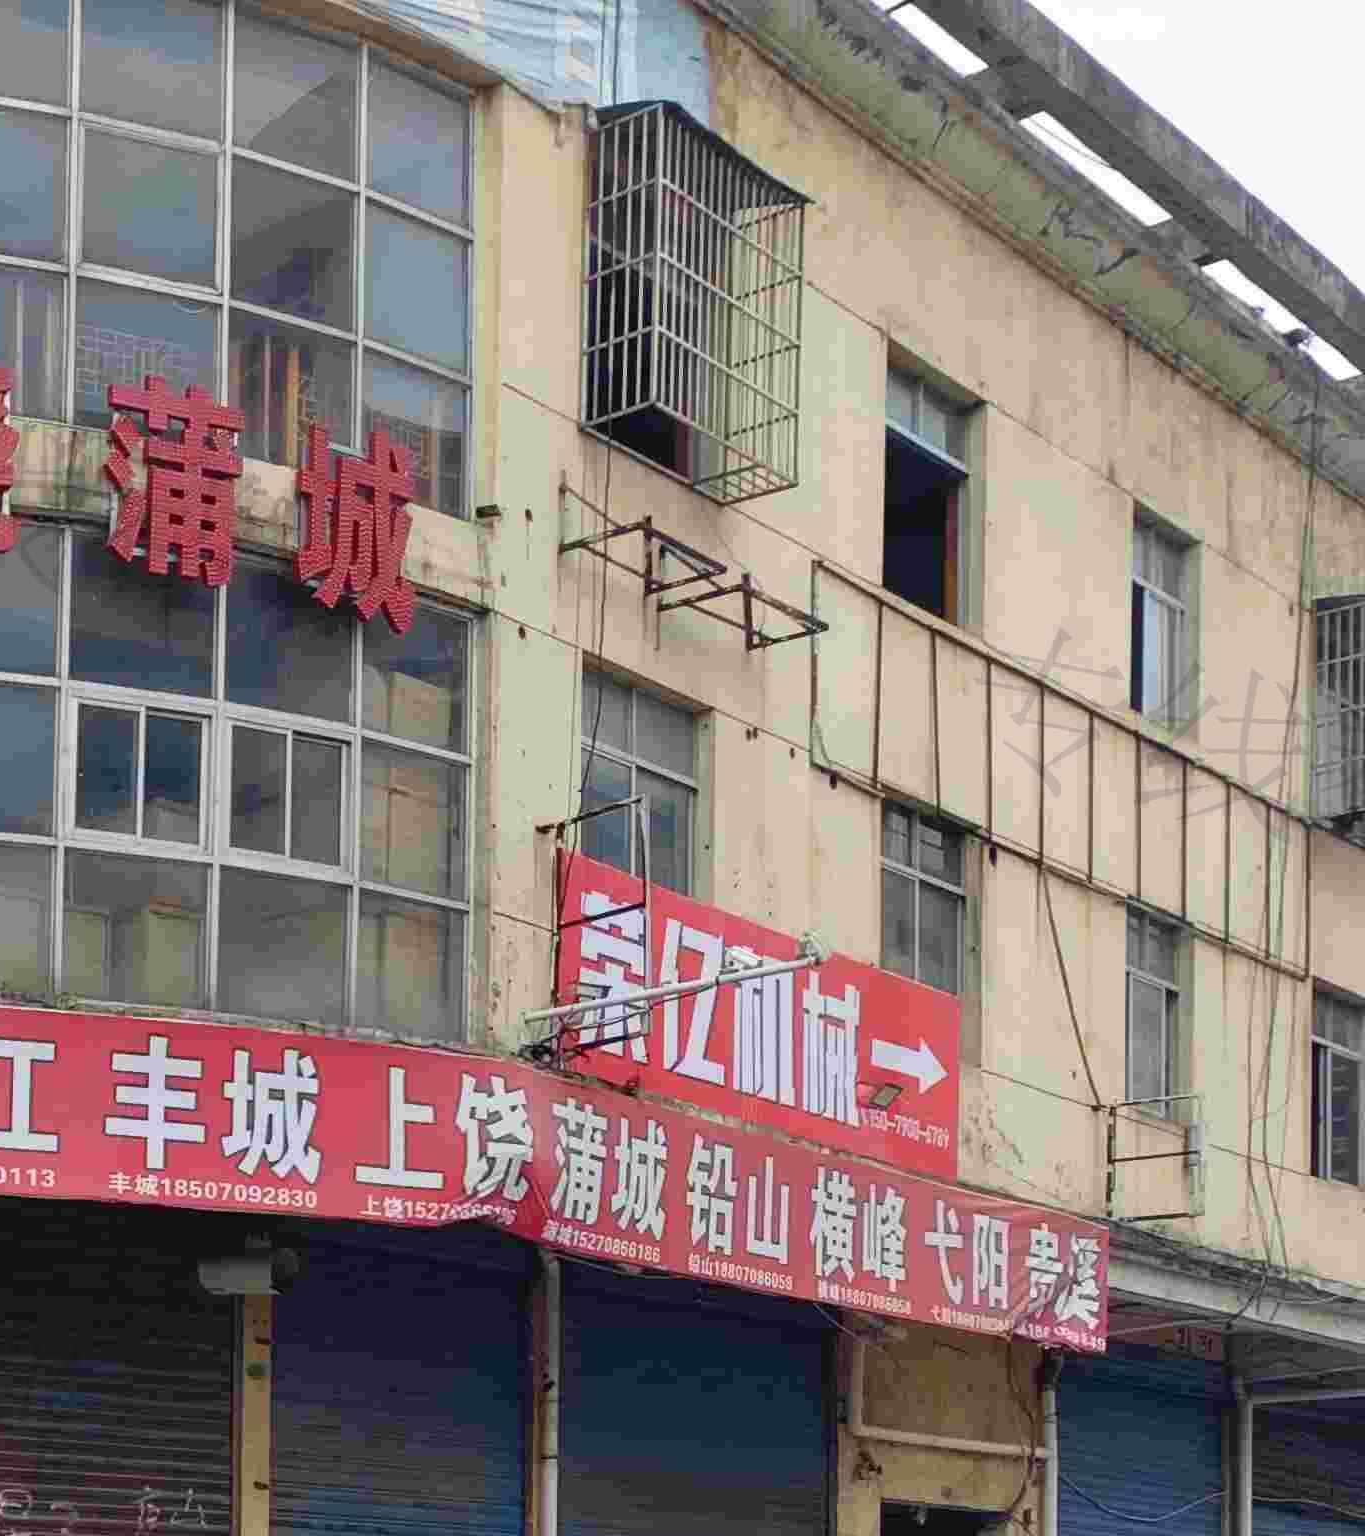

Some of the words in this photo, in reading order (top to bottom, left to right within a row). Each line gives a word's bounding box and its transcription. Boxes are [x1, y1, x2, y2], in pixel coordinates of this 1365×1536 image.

[580, 891, 861, 1129] 荣亿机械
[104, 1035, 322, 1185] 丰城
[356, 1065, 534, 1201] 上饶
[549, 1096, 668, 1241] 蒲城
[686, 1133, 790, 1265] 铅山
[810, 1164, 907, 1292] 横峰
[925, 1199, 1010, 1311] 弋阳
